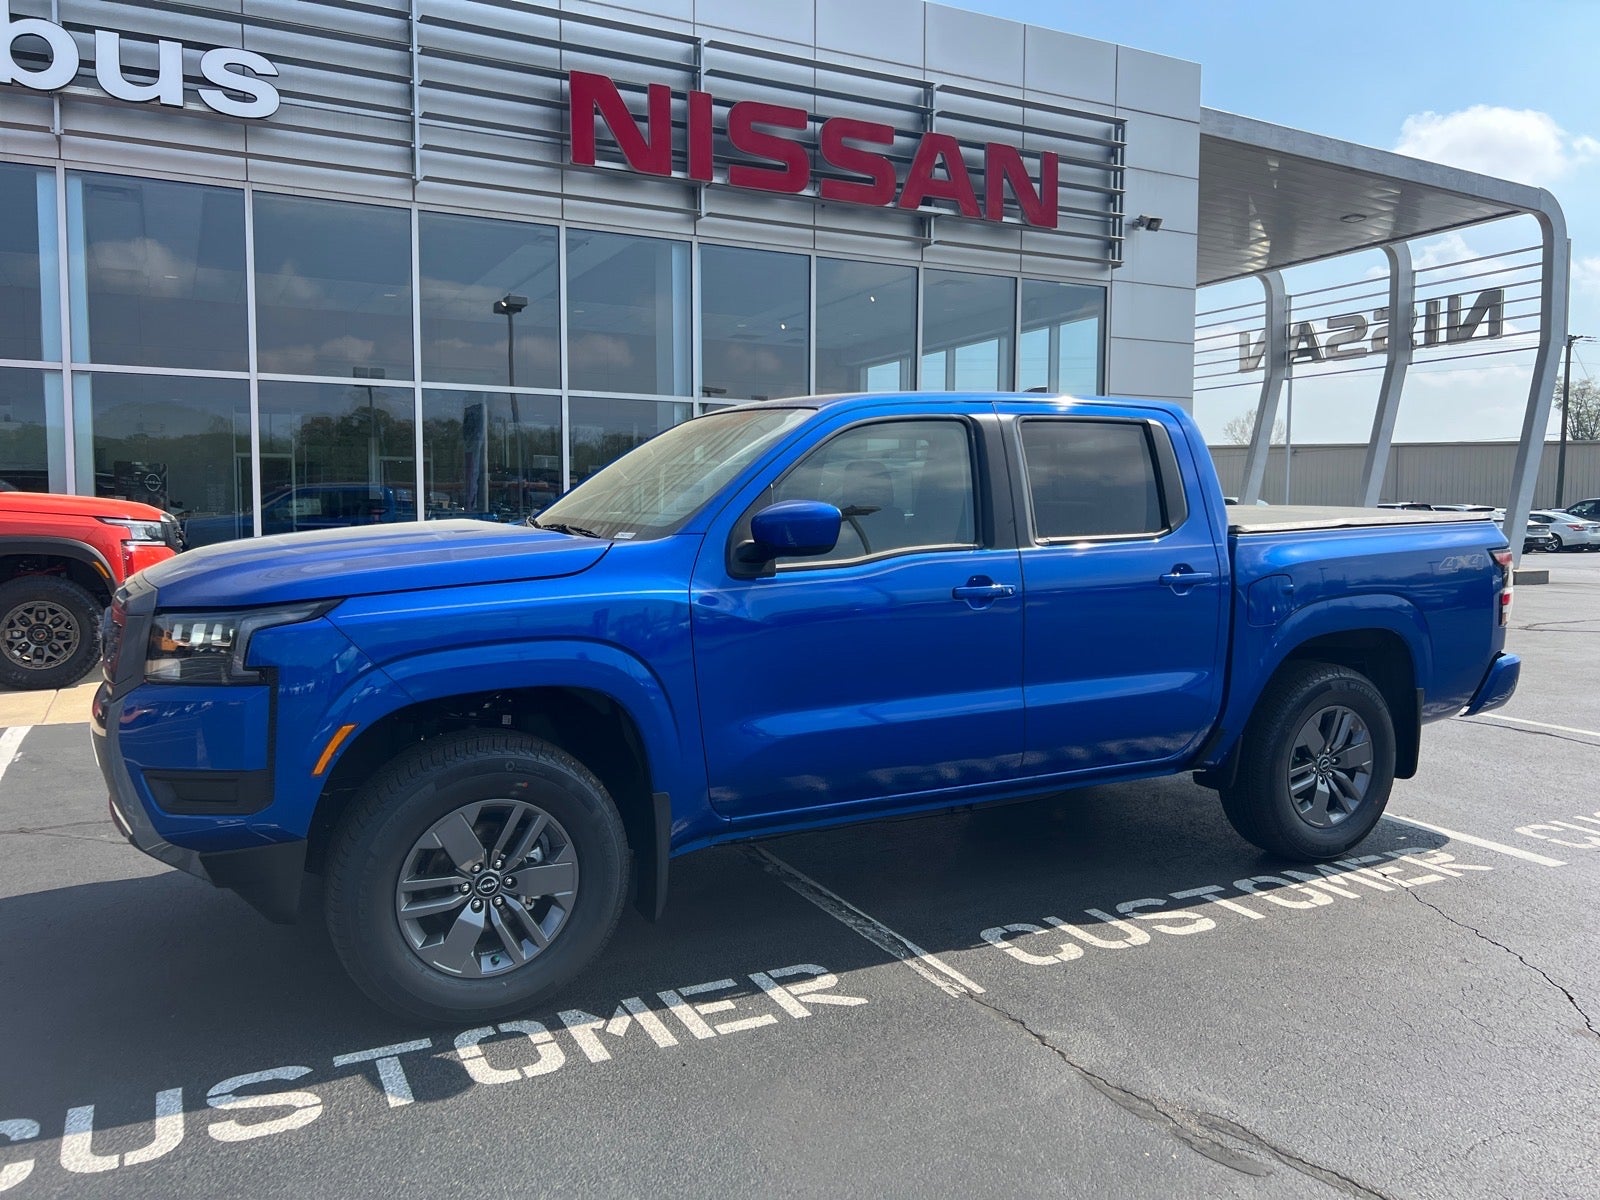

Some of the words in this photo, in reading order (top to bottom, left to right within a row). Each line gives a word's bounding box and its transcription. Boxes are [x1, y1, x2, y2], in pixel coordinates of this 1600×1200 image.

[0, 0, 280, 118] bus
[569, 70, 1058, 229] NISSAN
[980, 847, 1494, 965] CUSTOMER
